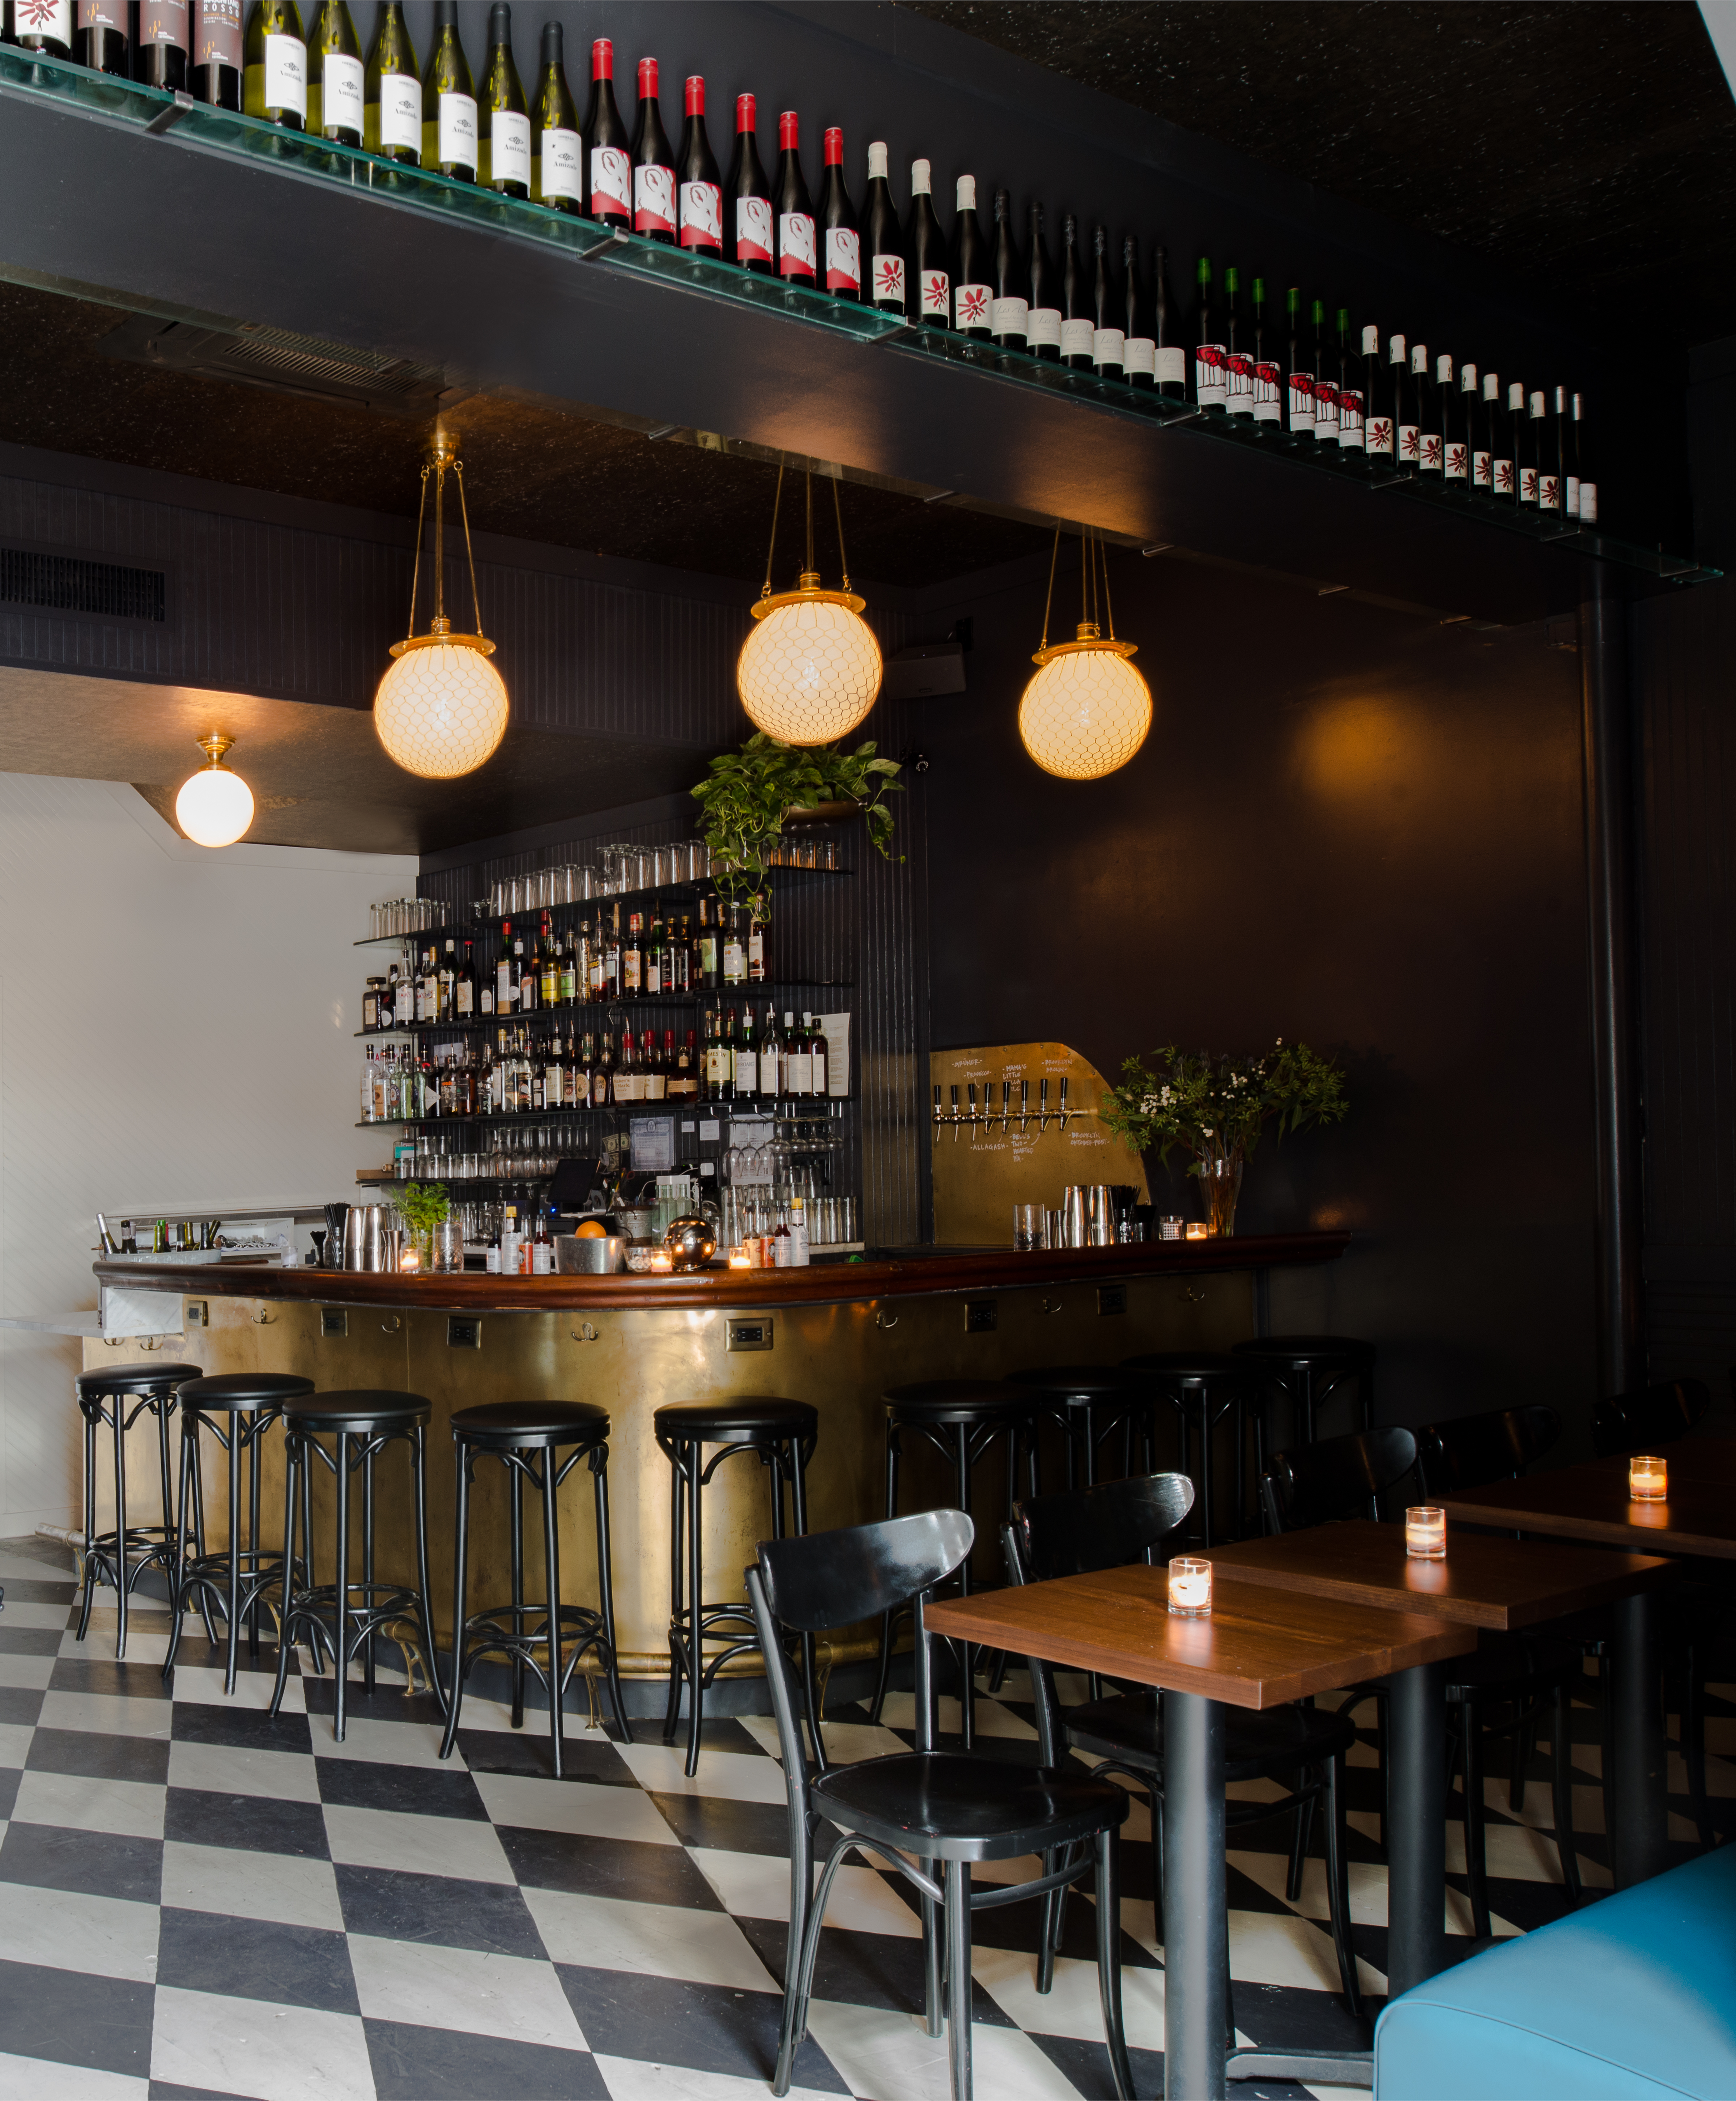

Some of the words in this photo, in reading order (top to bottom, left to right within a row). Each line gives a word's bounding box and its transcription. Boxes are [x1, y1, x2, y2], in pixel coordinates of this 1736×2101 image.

[204, 3, 239, 18] ROSSO
[504, 143, 527, 155] Amizade
[553, 161, 578, 170] Amizade
